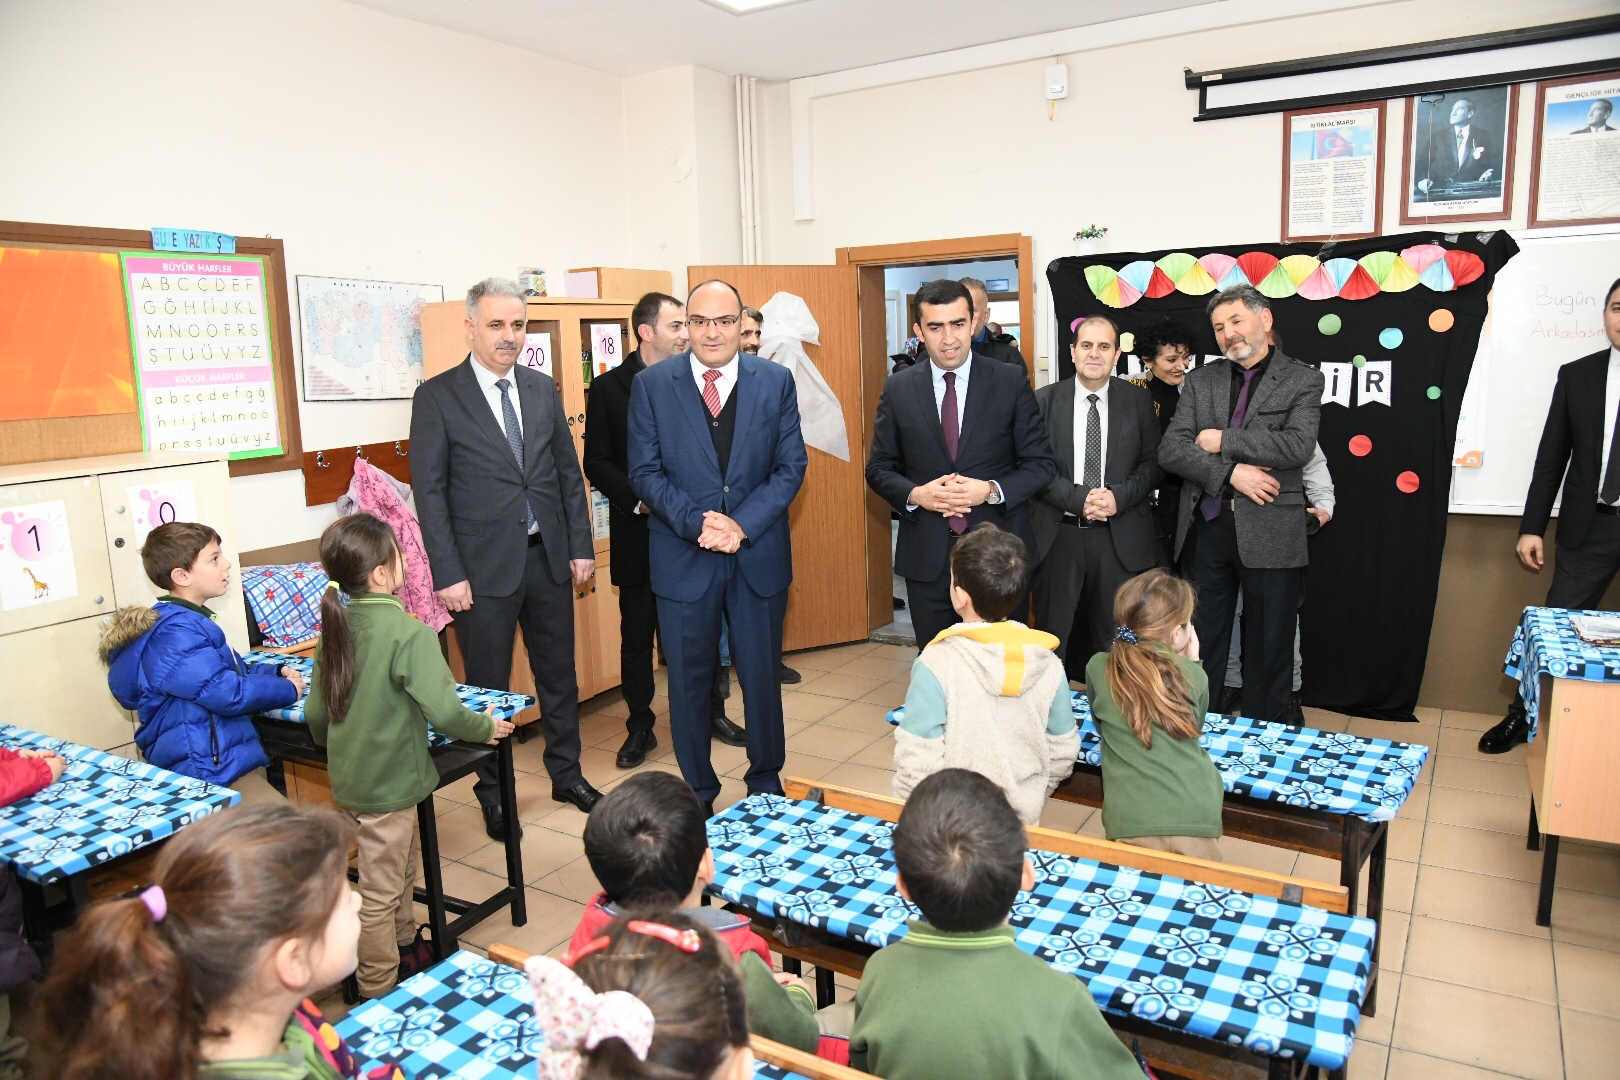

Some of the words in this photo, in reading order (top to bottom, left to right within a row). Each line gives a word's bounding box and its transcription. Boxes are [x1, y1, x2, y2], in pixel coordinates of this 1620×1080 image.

[162, 262, 196, 272] BÜYÜK
[198, 263, 233, 273] HARFLER
[1535, 285, 1596, 314] Bugün
[602, 337, 615, 354] 18
[526, 347, 545, 367] 20
[175, 373, 207, 385] KÜÇÜK
[209, 372, 245, 382] HARFLER
[1465, 456, 1478, 464] 25
[27, 524, 41, 552] 1
